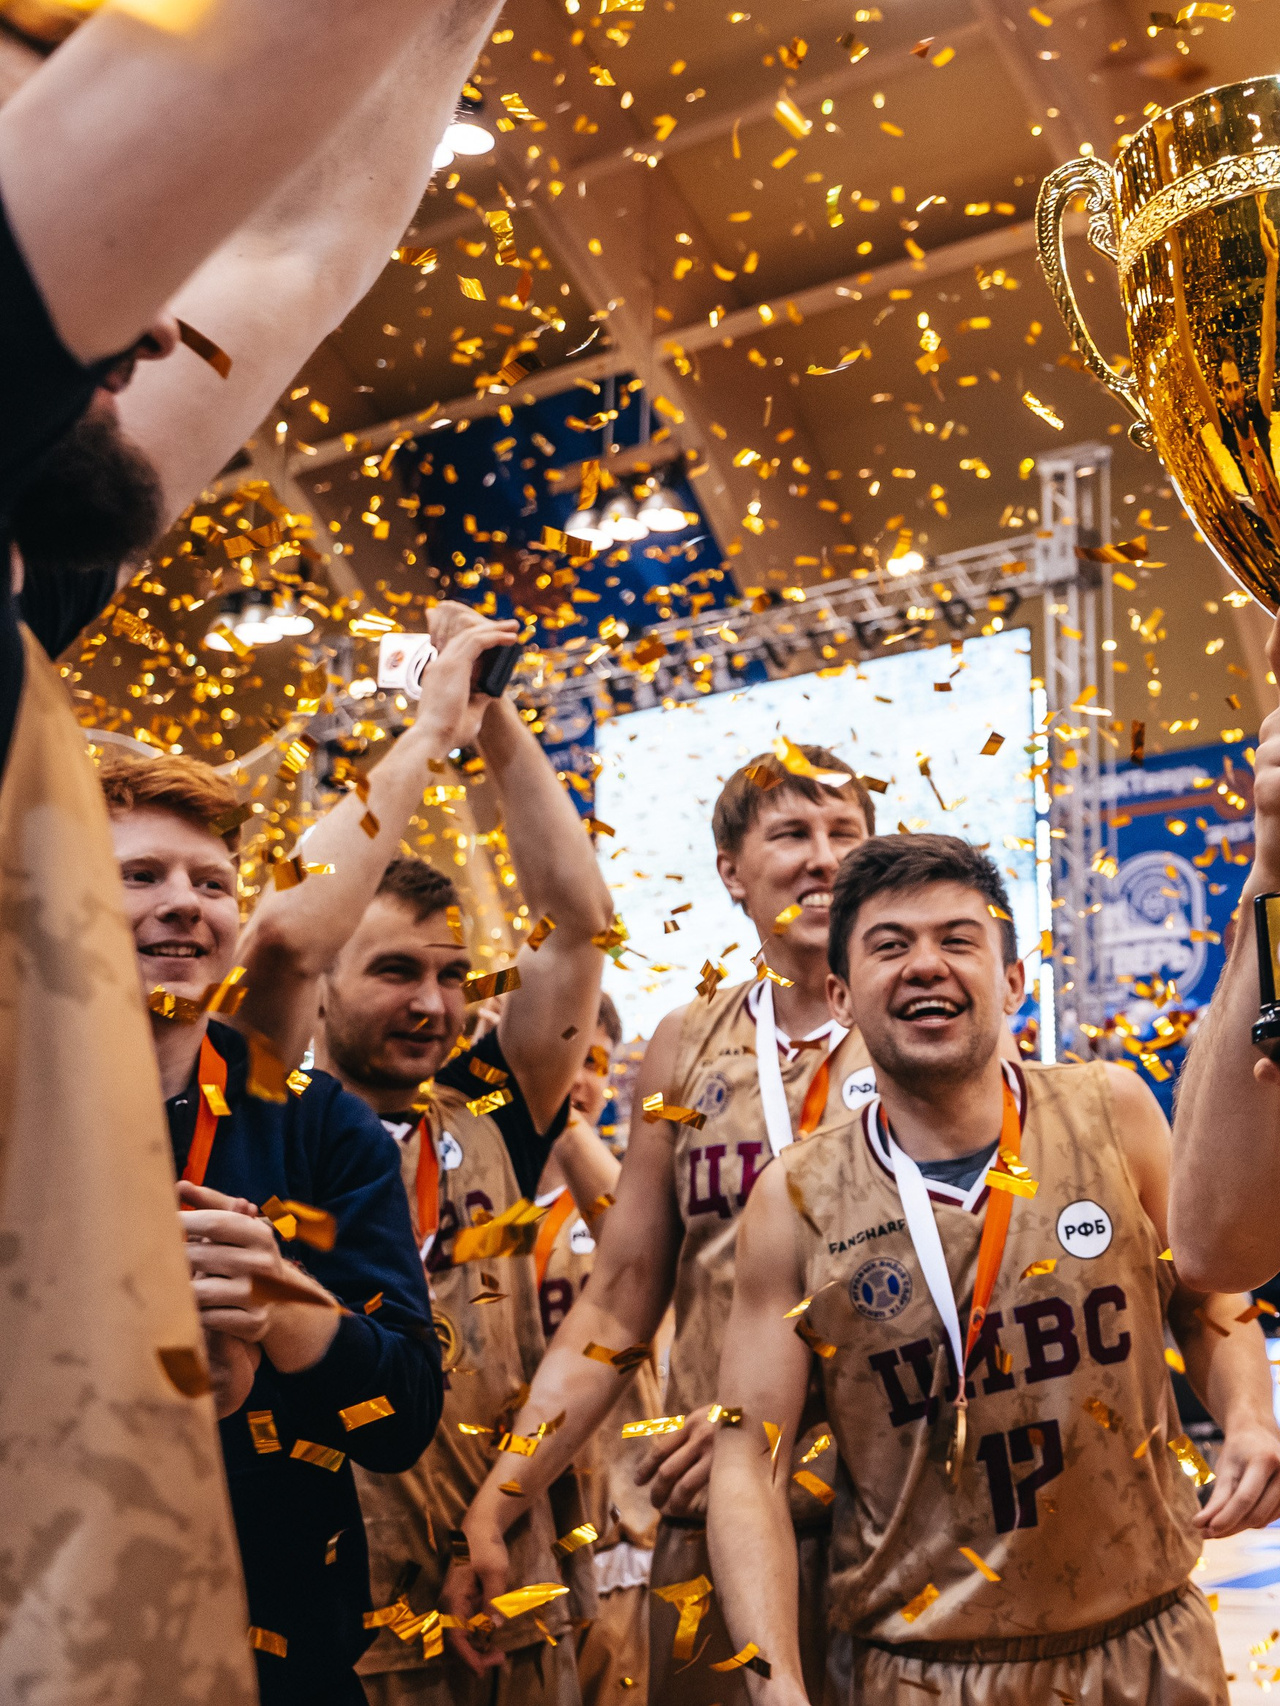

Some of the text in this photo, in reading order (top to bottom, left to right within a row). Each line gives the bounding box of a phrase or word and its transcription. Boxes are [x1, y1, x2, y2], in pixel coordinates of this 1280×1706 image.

[1064, 1218, 1107, 1242] РФБ
[869, 1284, 1132, 1428] ЦИВС
[976, 1419, 1064, 1534] 17
